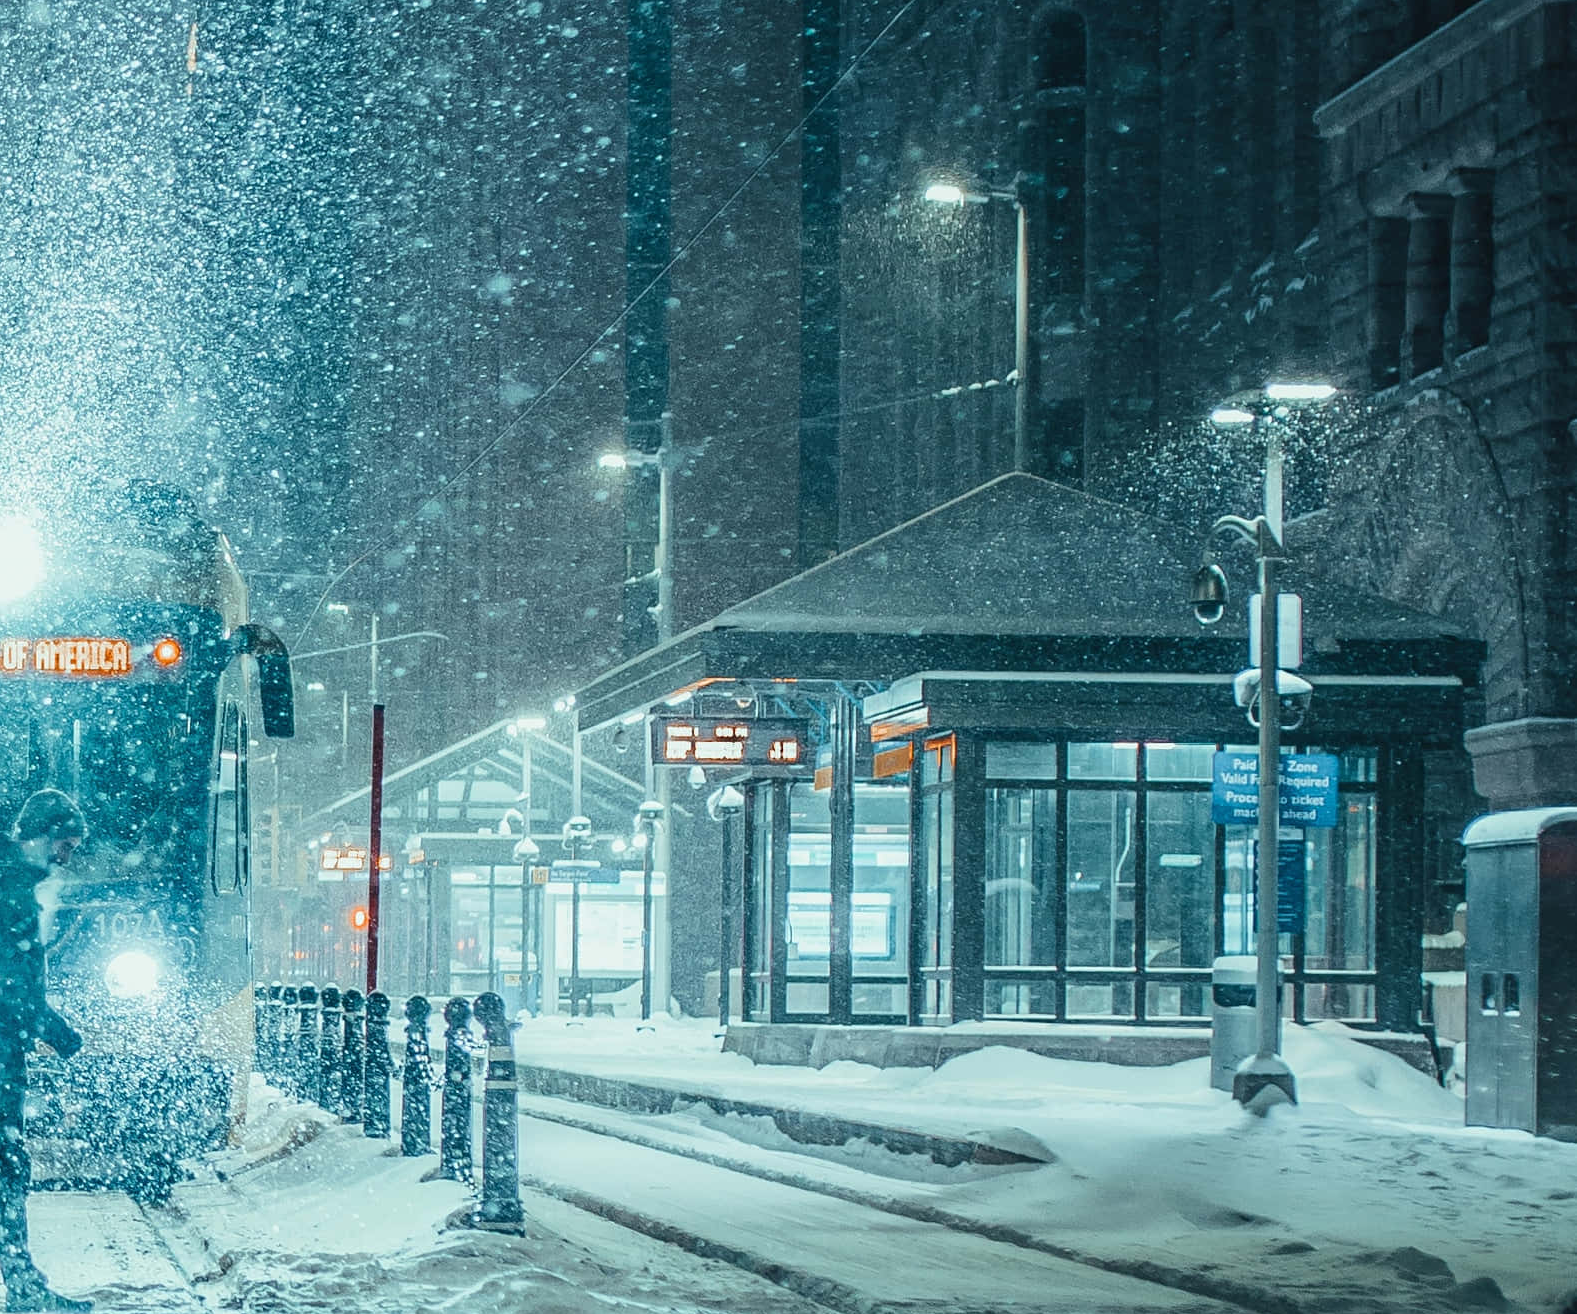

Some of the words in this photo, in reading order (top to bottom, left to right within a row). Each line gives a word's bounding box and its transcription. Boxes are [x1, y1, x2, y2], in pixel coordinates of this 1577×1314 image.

[3, 641, 29, 669] OF
[35, 641, 127, 670] AMERICA
[1233, 758, 1257, 771] Paid
[1287, 760, 1319, 773] Zone
[1221, 773, 1248, 784] Valid
[1282, 809, 1316, 820] ahead
